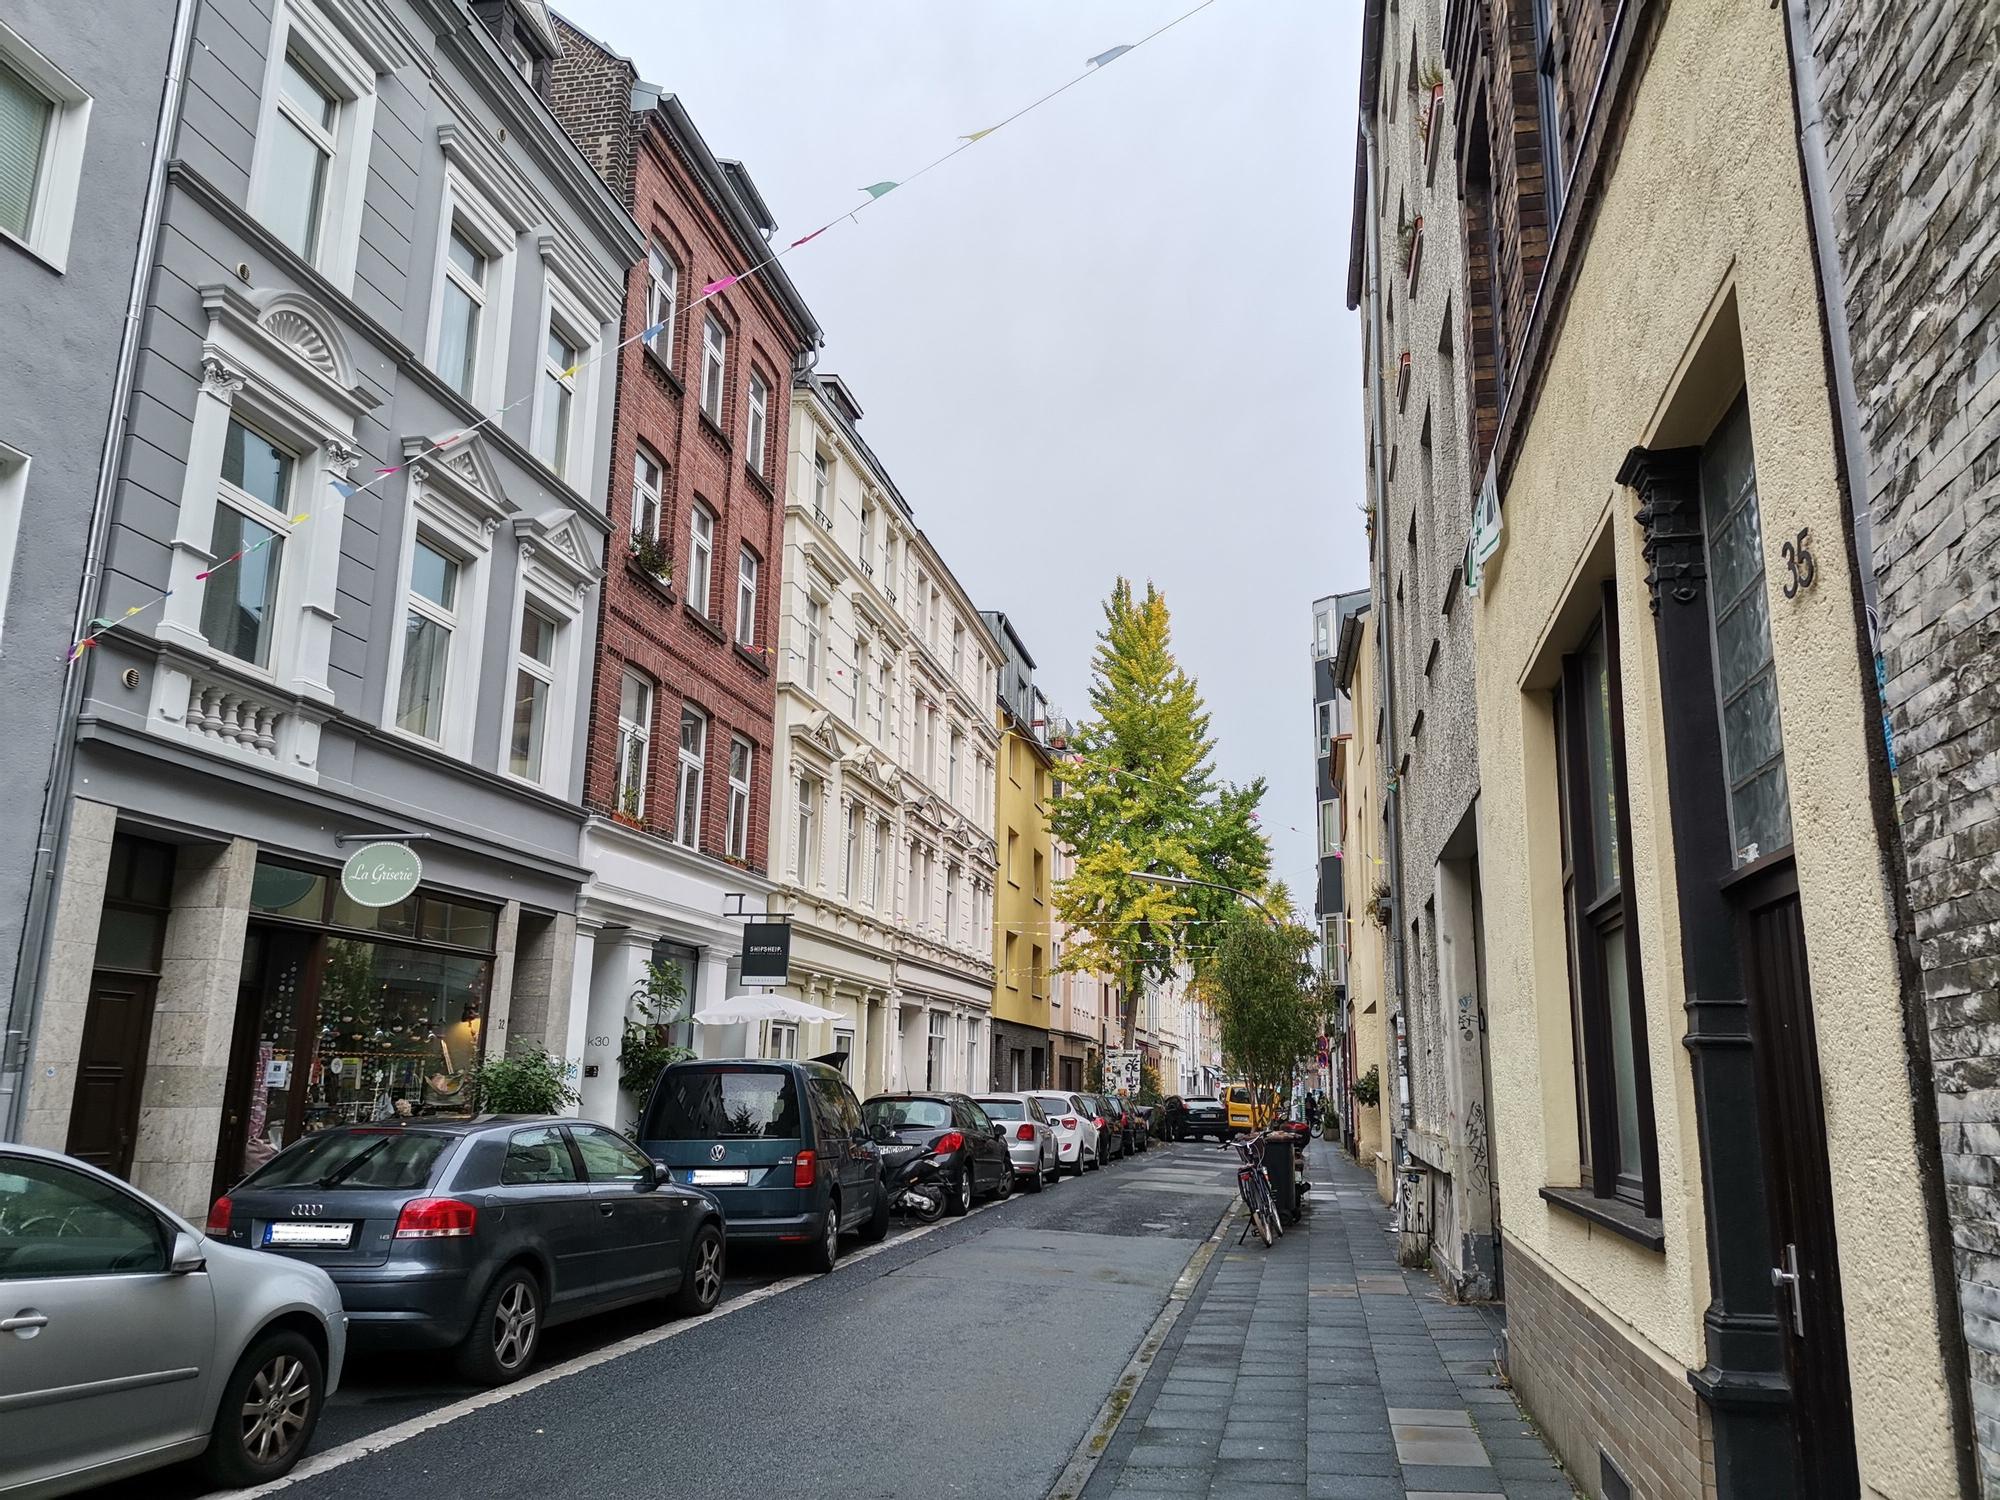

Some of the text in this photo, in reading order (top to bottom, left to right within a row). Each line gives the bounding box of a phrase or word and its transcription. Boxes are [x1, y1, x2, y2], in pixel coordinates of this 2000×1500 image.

[1781, 527, 1814, 599] 35
[349, 864, 413, 886] La Griserie
[587, 1036, 610, 1047] k30
